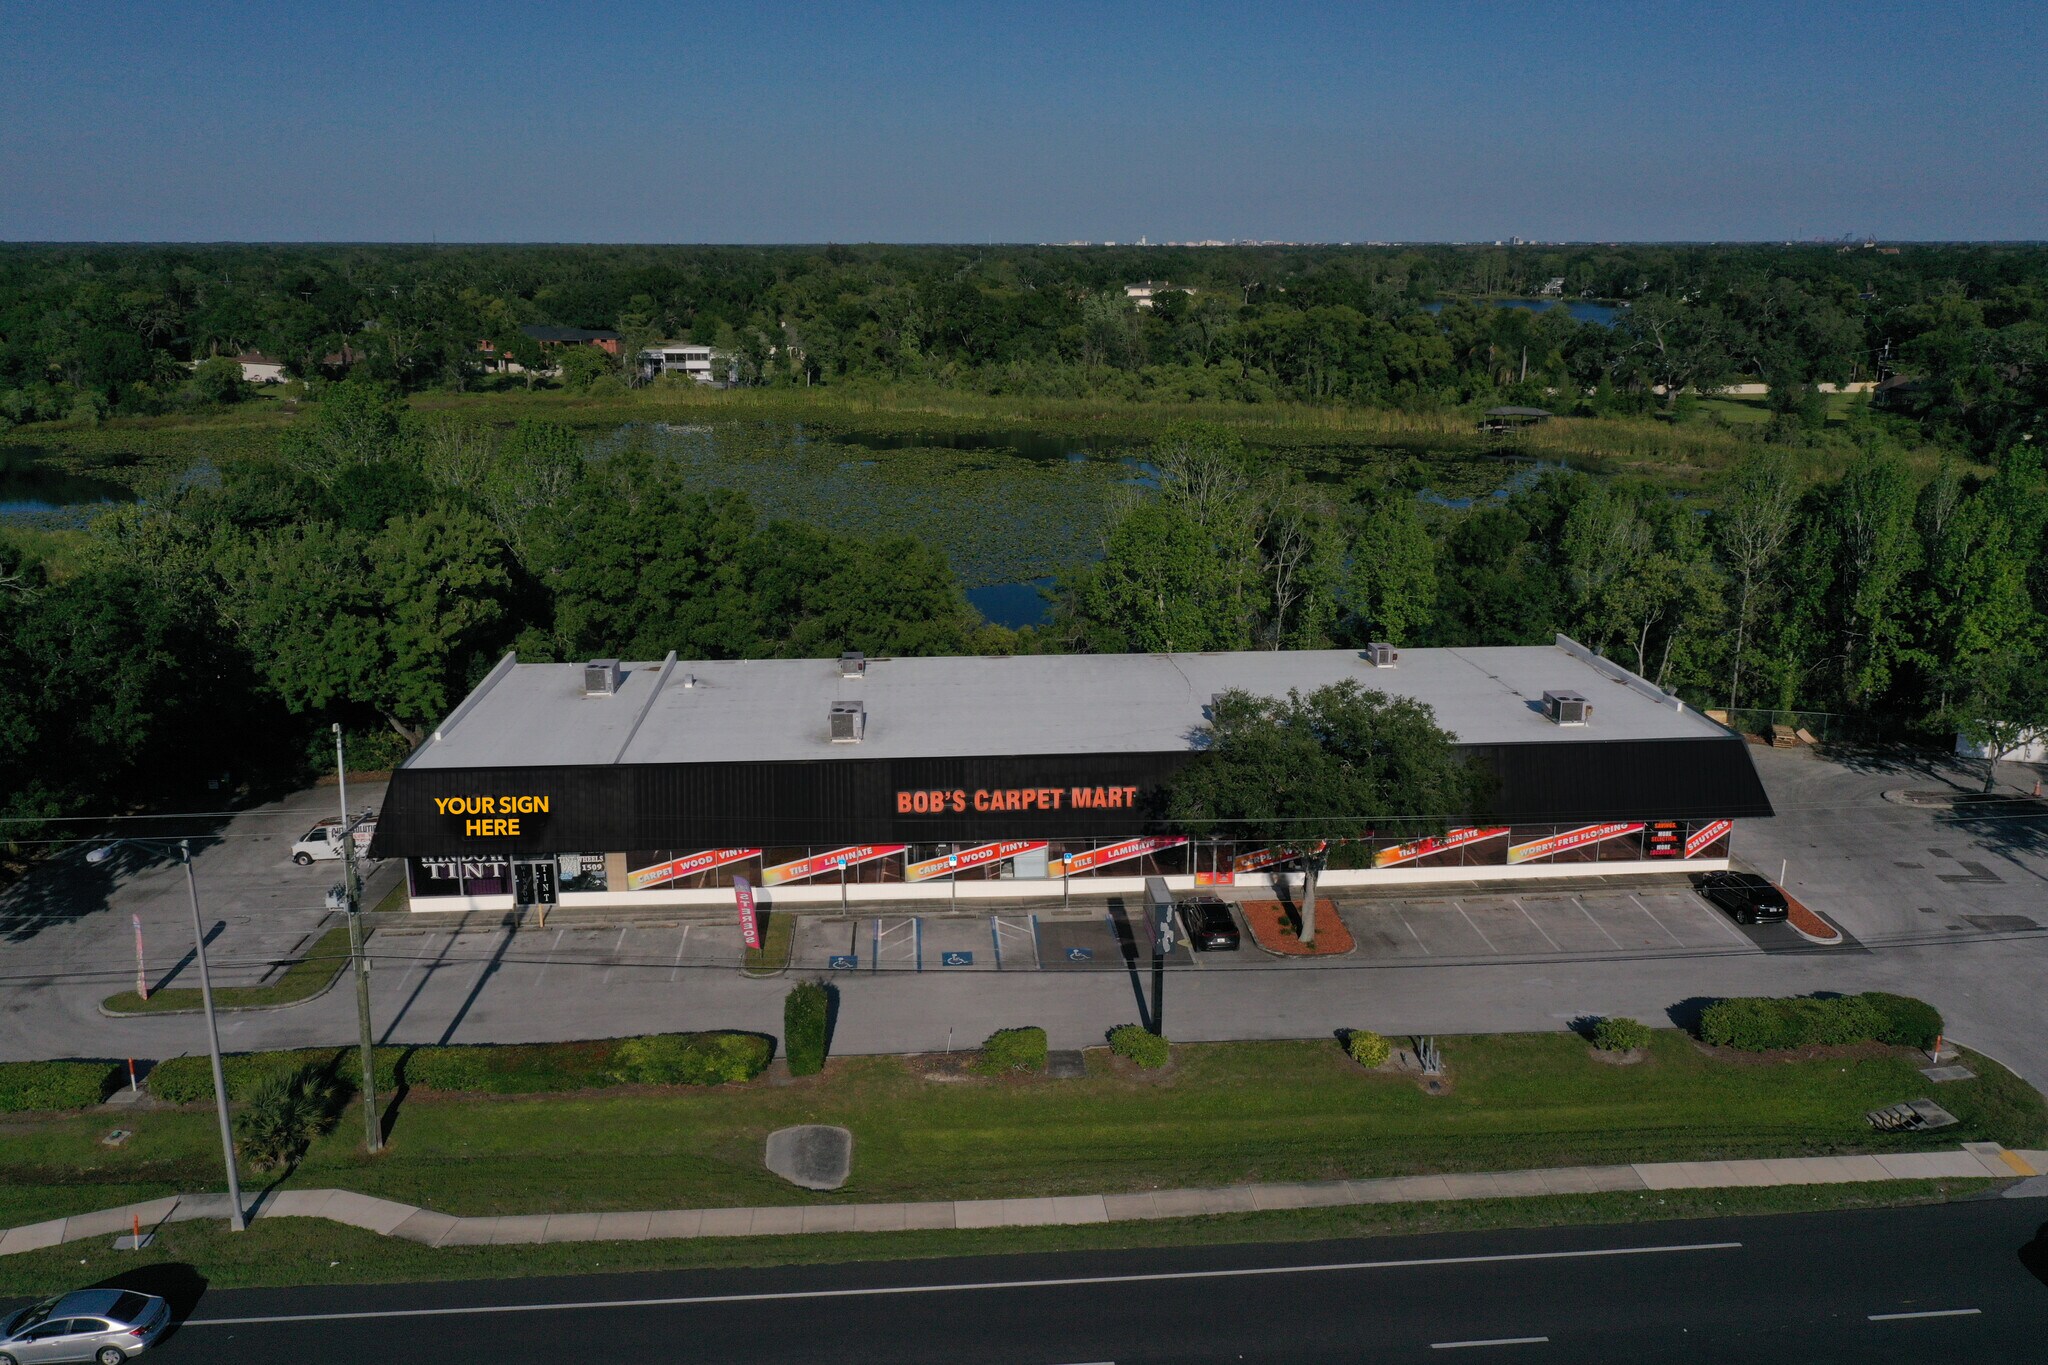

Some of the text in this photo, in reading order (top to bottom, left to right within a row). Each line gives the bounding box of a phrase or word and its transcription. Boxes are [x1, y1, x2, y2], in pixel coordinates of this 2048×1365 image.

[897, 786, 1137, 813] BOB'S CARPET MART
[1580, 823, 1628, 841] FLOORING
[1687, 819, 1729, 851] SHUTTERS
[918, 841, 1029, 875] CARPE WOOD VINYL
[1073, 839, 1156, 868] TILE LAMINATE
[421, 862, 509, 879] TINT
[541, 864, 550, 902] TINT
[638, 867, 672, 883] CARPET
[680, 855, 713, 871] WOOD
[788, 864, 809, 876] TILE
